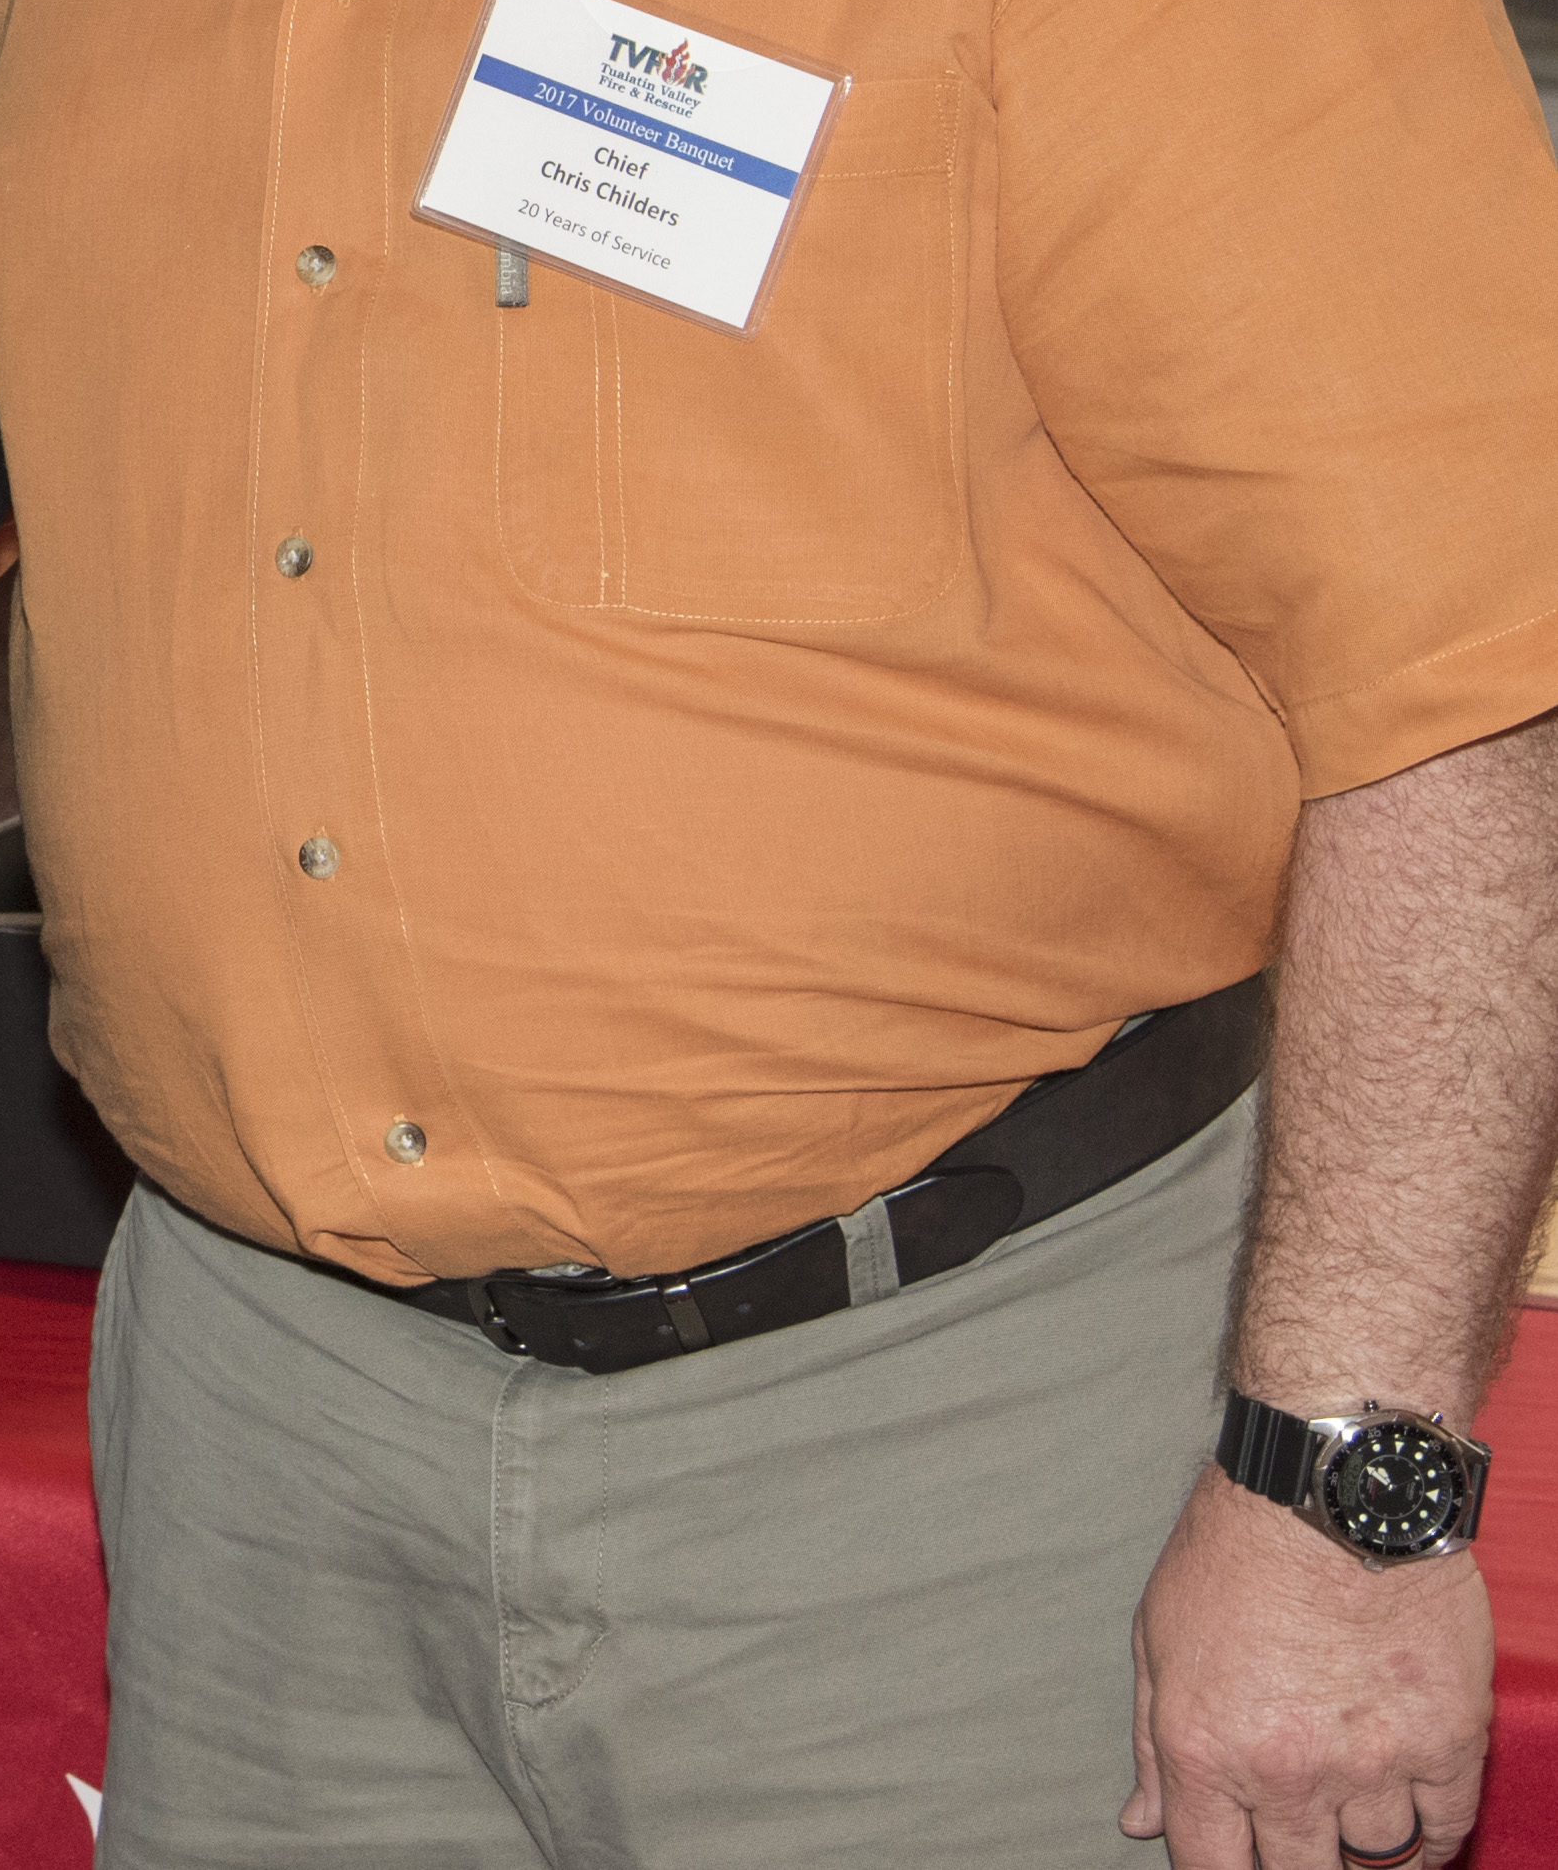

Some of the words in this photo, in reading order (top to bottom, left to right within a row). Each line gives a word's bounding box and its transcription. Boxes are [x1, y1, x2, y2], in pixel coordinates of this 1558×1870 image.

[598, 75, 626, 93] Fire
[629, 87, 641, 99] &
[644, 91, 694, 119] Rescue
[601, 62, 656, 92] Tualatin
[660, 84, 702, 110] Valley
[533, 81, 578, 112] 2017
[582, 98, 663, 143] Volunteer
[664, 132, 736, 172] Banquet
[594, 145, 651, 181] Chief
[540, 159, 591, 193] Chris
[596, 180, 680, 227] Childers
[517, 198, 540, 220] 20
[543, 207, 588, 238] Years
[590, 227, 610, 247] of
[611, 234, 672, 270] Service
